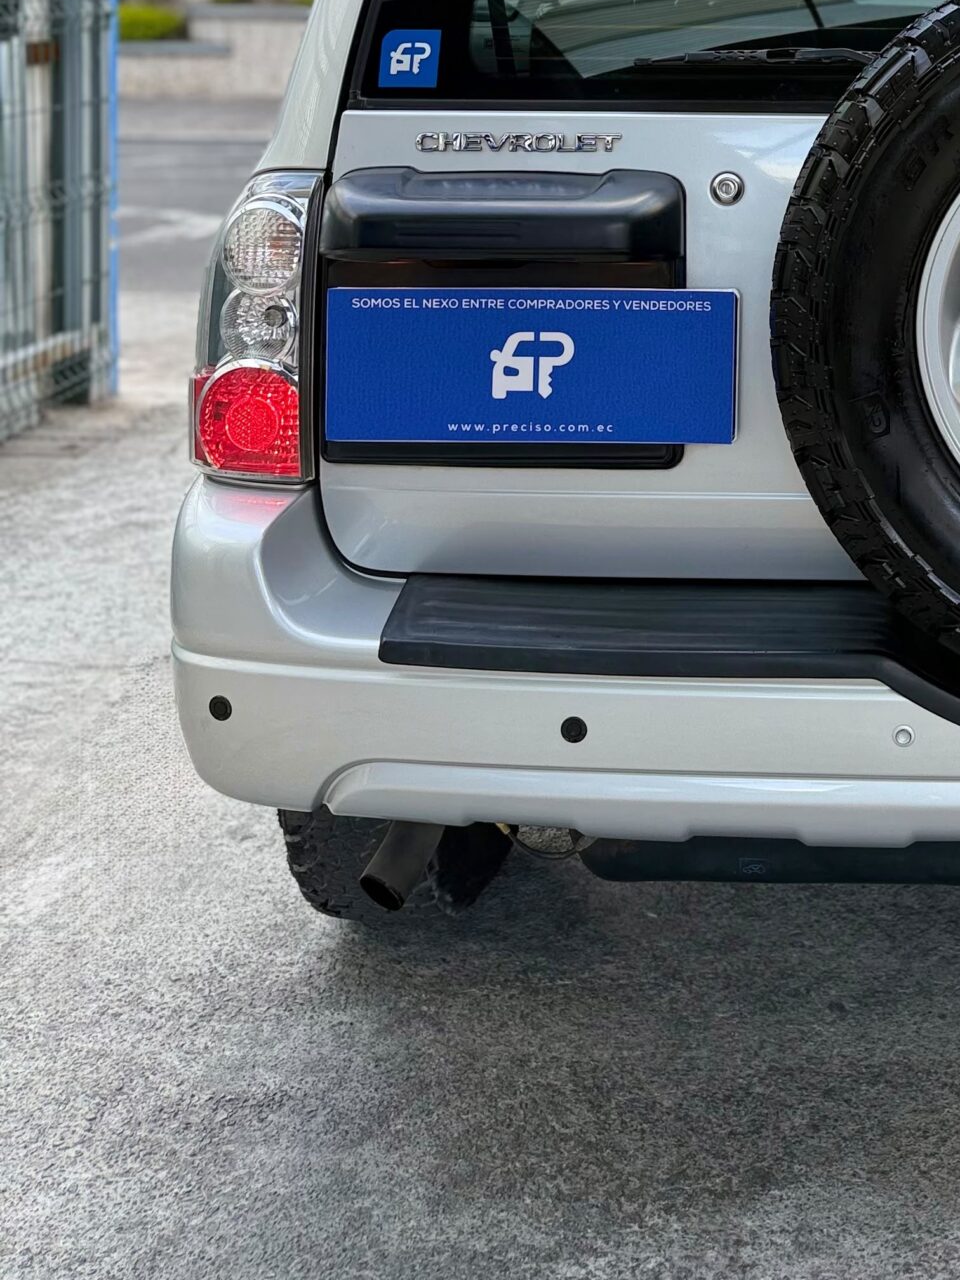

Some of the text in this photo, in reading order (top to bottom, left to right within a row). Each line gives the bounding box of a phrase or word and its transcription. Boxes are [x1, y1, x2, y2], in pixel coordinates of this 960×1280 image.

[415, 132, 622, 152] CHEVROLET
[351, 298, 712, 312] SOMOS EL NEXO ENTRE COMPRADORES Y VENDEDORES
[447, 421, 614, 434] www.preciso.com.ec
